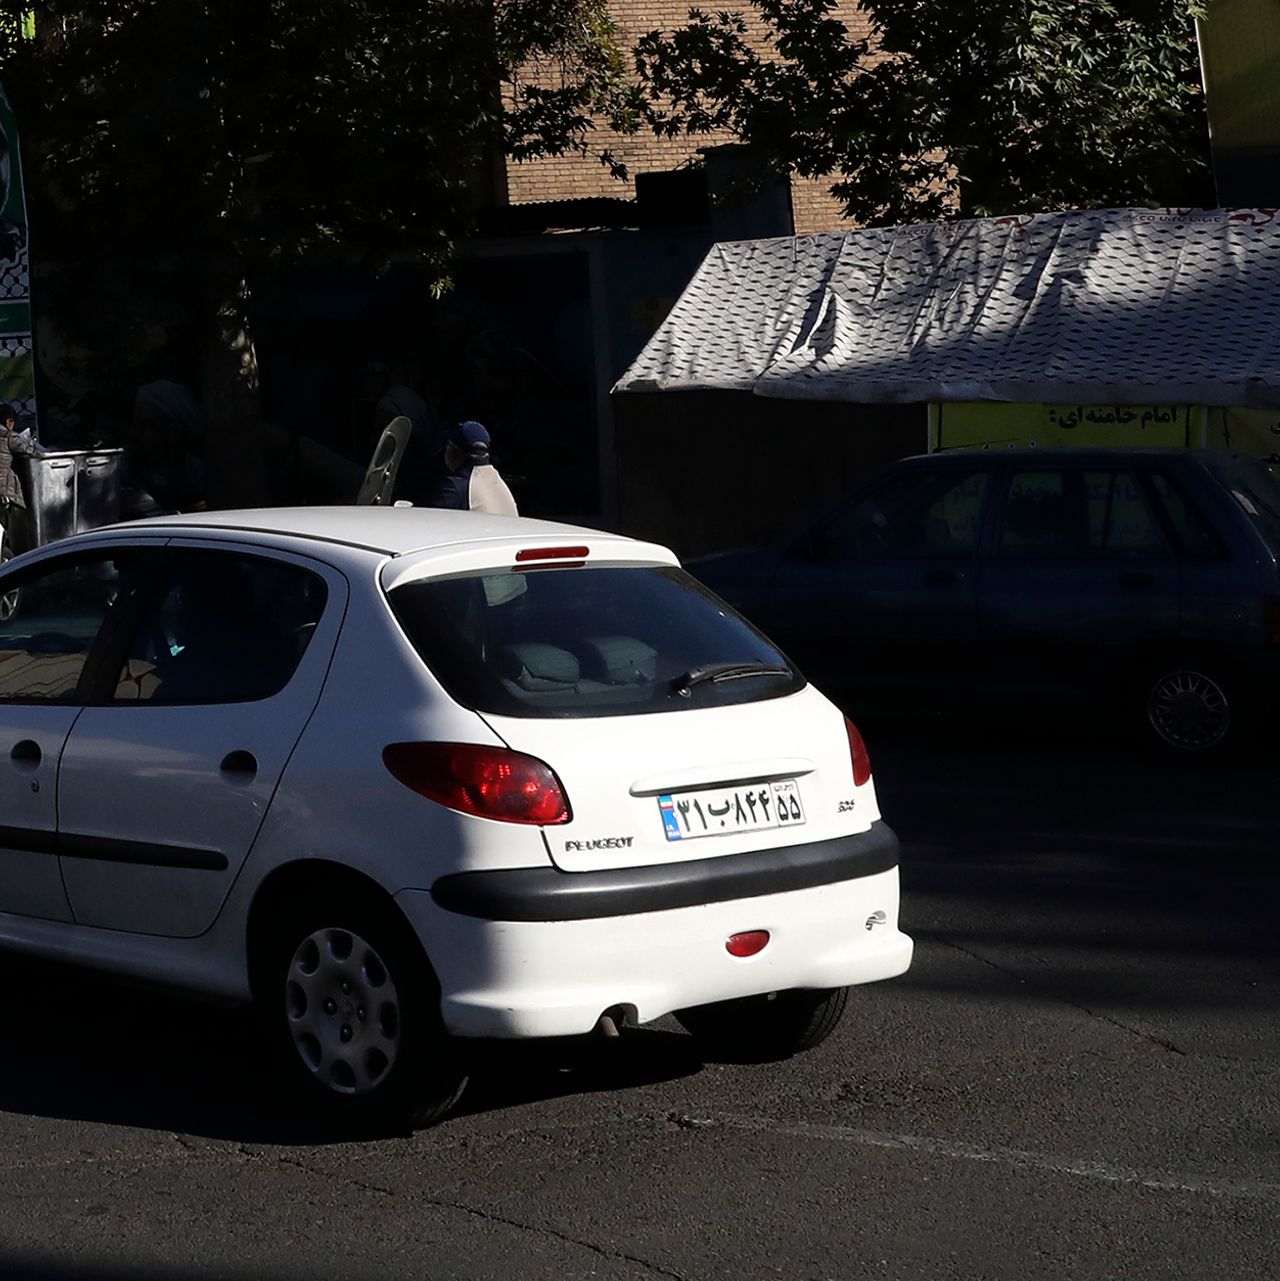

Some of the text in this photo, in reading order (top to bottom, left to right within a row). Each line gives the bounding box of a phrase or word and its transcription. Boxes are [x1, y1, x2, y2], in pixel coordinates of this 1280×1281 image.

[1141, 407, 1177, 429] امام
[777, 793, 801, 821] ۵۵
[565, 836, 634, 852] PEUGEOT
